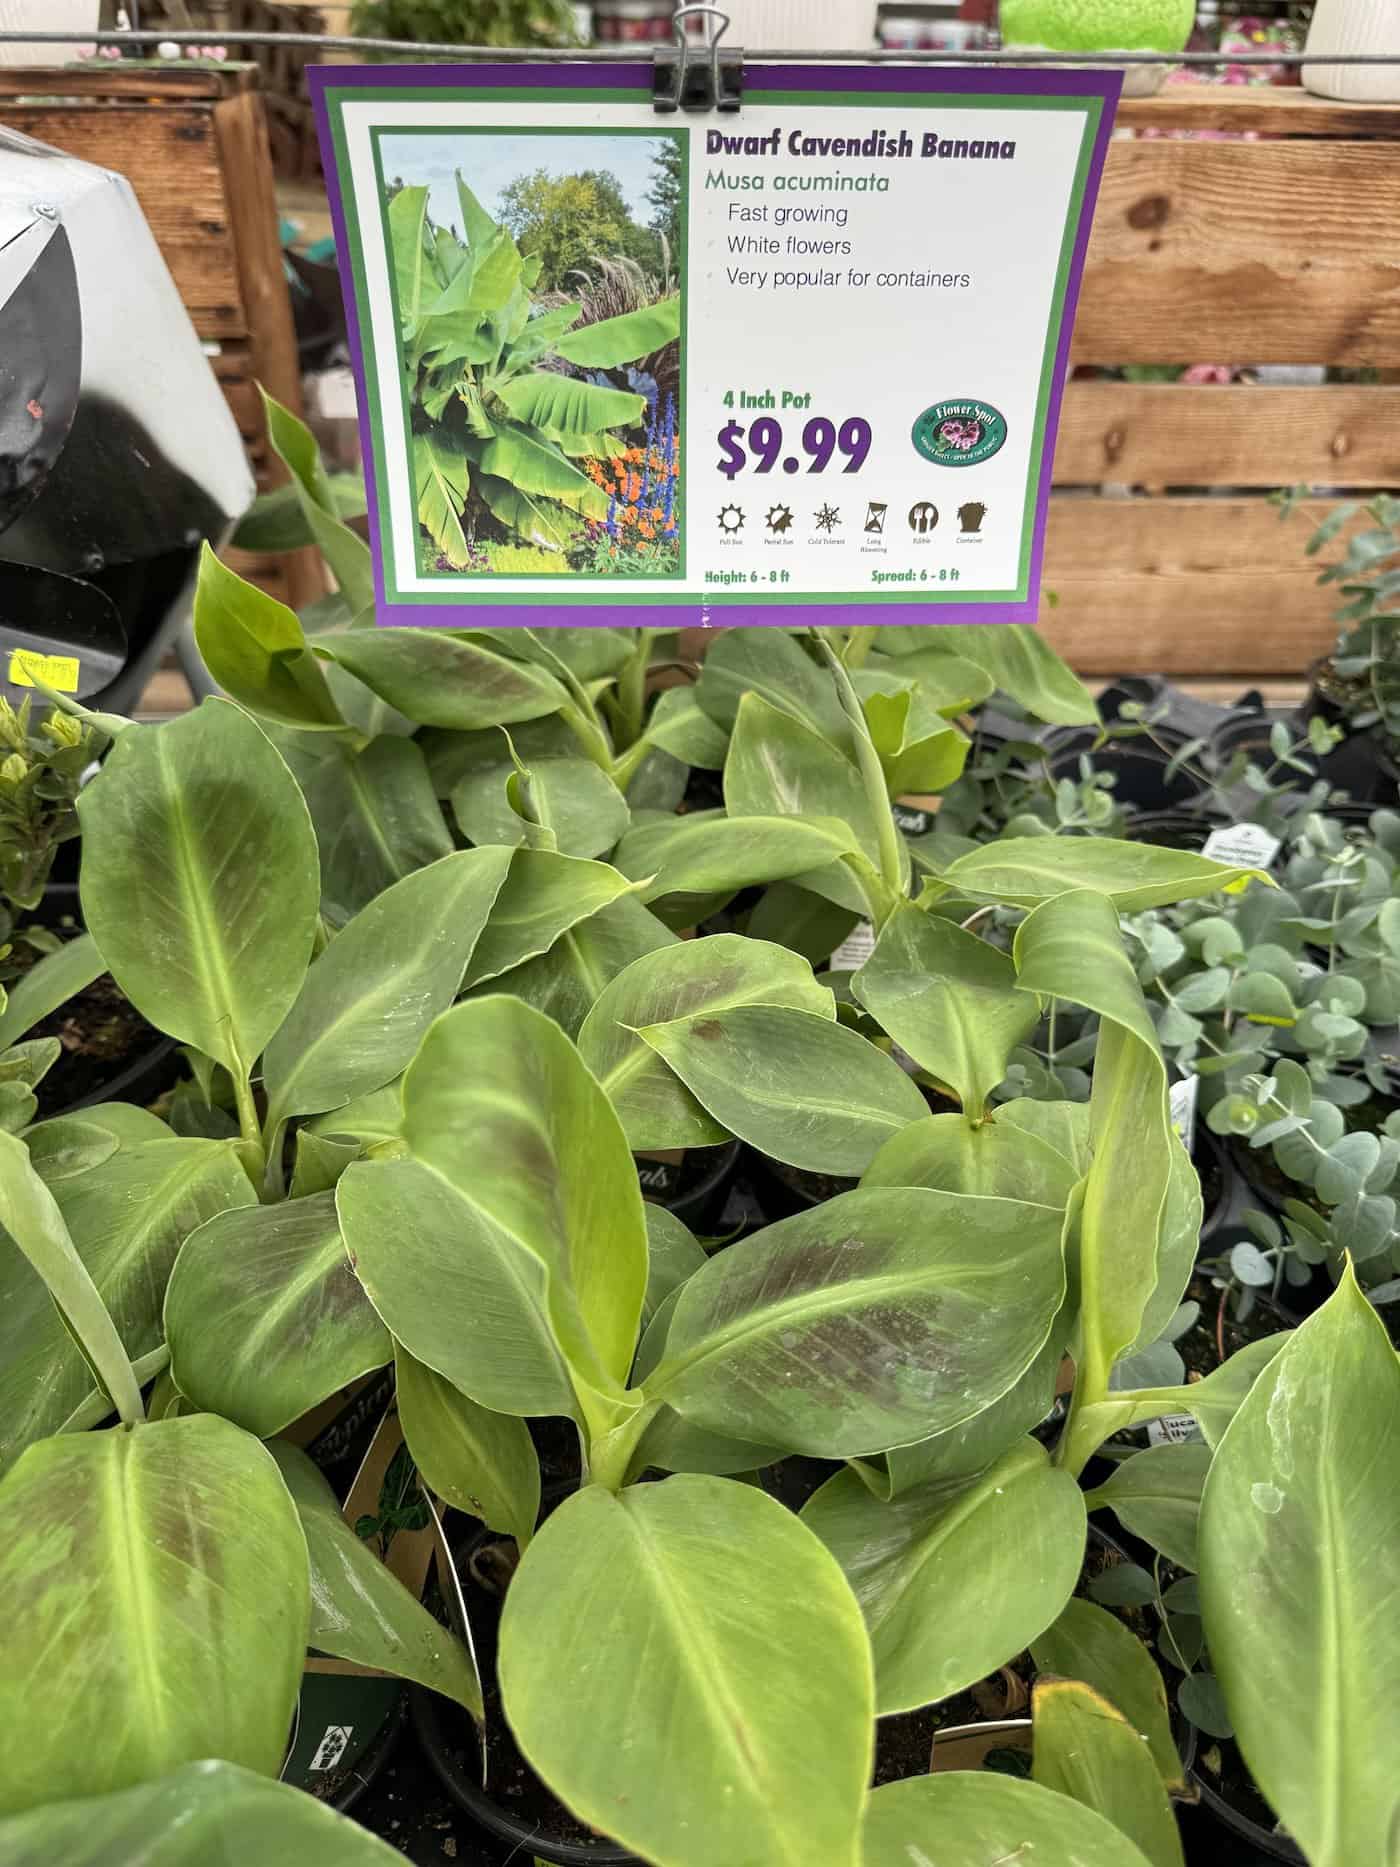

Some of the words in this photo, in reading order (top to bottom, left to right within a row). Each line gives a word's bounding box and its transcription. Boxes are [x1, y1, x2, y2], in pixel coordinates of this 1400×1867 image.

[706, 128, 781, 156] Dwarf
[788, 130, 914, 158] Cavendish
[920, 132, 1017, 160] Banana
[705, 169, 764, 190] Musa
[773, 170, 889, 193] acuminata
[728, 203, 768, 222] Fast
[774, 204, 849, 227] growing
[727, 235, 781, 254] White
[786, 236, 852, 255] flowers
[726, 266, 768, 289] Very
[773, 269, 843, 290] popular
[847, 268, 871, 287] for
[876, 270, 971, 289] containers
[723, 391, 735, 409] 4
[740, 389, 776, 409] Inch
[781, 391, 812, 409] Pot
[936, 405, 972, 419] Flower
[974, 405, 996, 425] Spot
[717, 416, 873, 481] $9.99
[704, 570, 747, 585] Height:
[750, 570, 758, 583] 6
[769, 570, 777, 583] 8
[780, 569, 790, 583] ft
[871, 568, 917, 584] Spread:
[919, 569, 928, 581] 6
[939, 568, 947, 581] 8
[950, 568, 960, 581] ft
